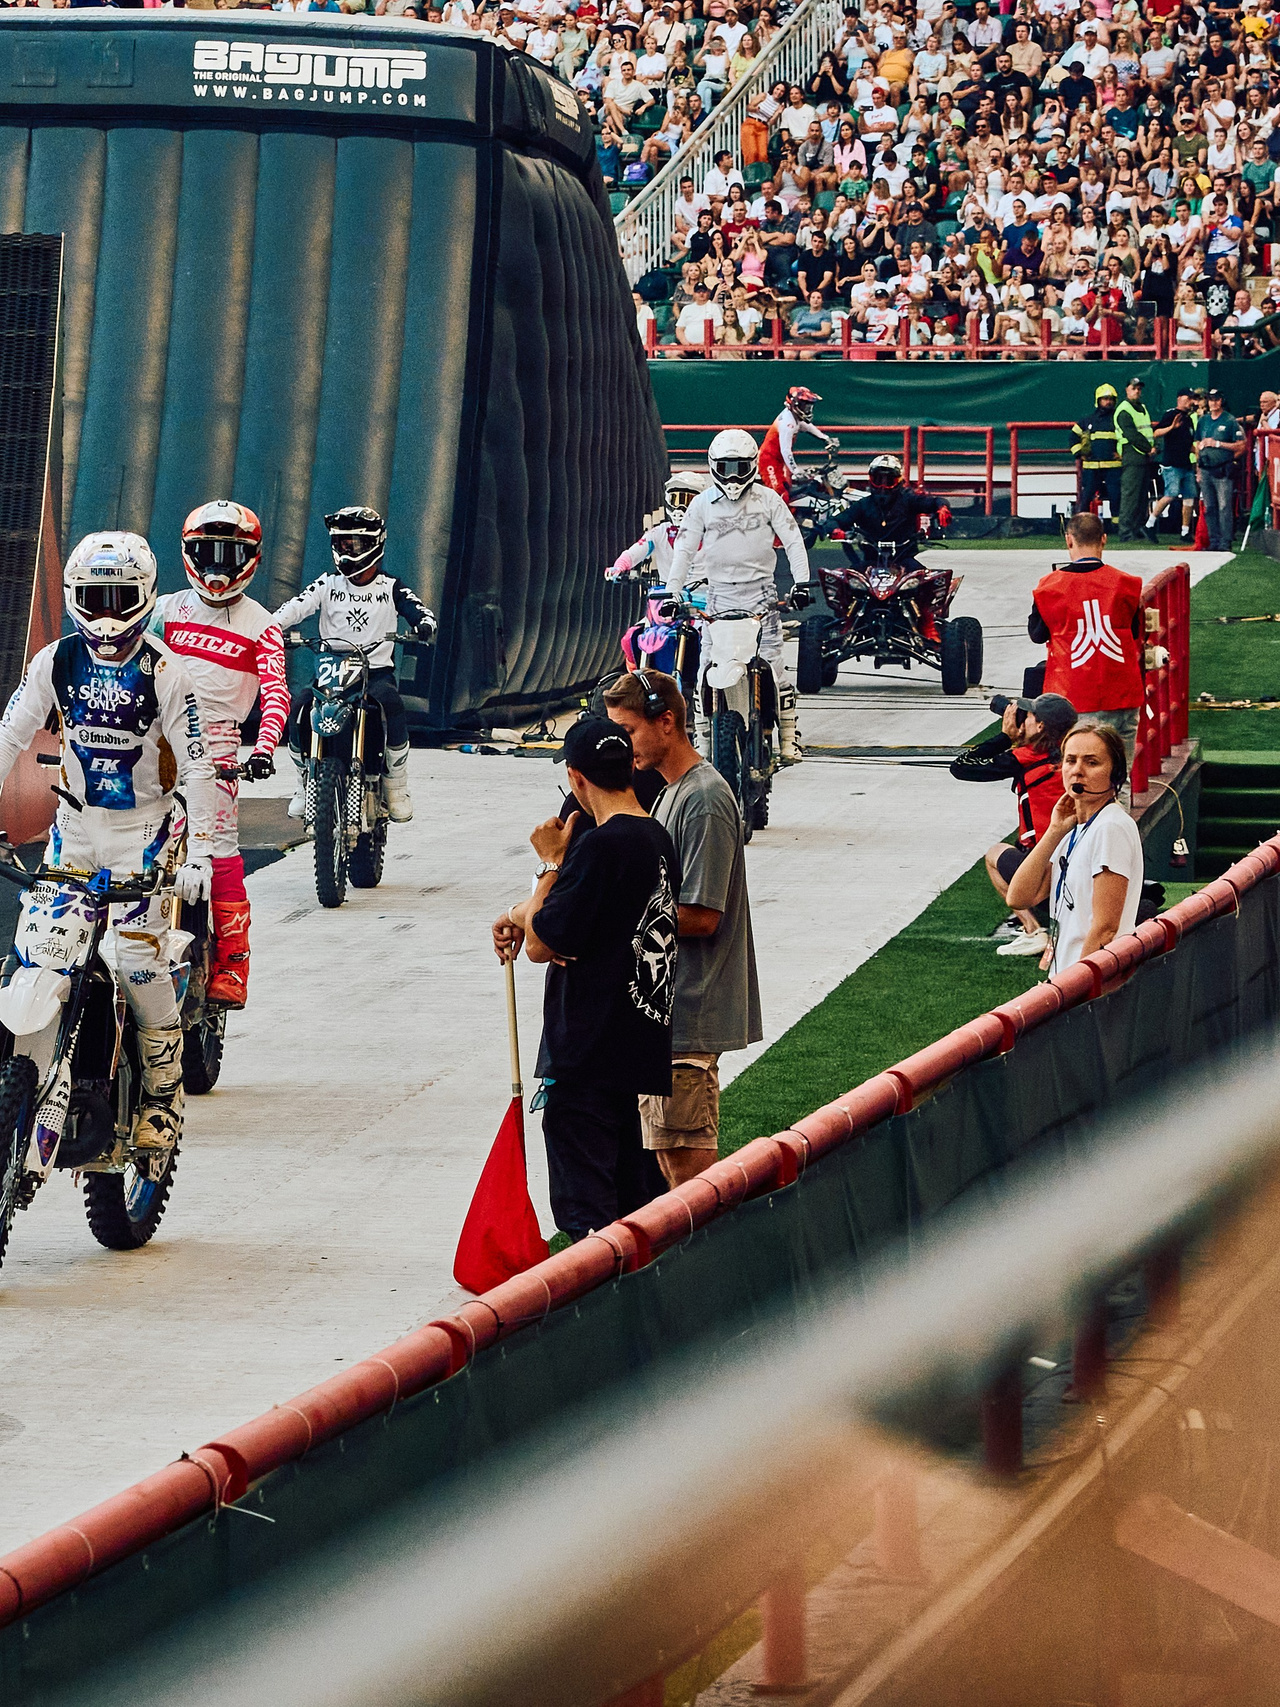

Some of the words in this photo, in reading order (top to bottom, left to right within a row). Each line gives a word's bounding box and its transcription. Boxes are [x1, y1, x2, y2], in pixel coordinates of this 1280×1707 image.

[193, 40, 427, 89] BAGJUMP
[193, 71, 214, 81] THE
[215, 72, 263, 83] ORIGINAL
[349, 592, 373, 604] YOUR
[318, 660, 363, 687] 247
[78, 685, 132, 706] SENDS
[87, 699, 119, 712] ONLY
[90, 757, 121, 771] FK
[49, 925, 69, 936] FK
[627, 980, 662, 1024] NEVER
